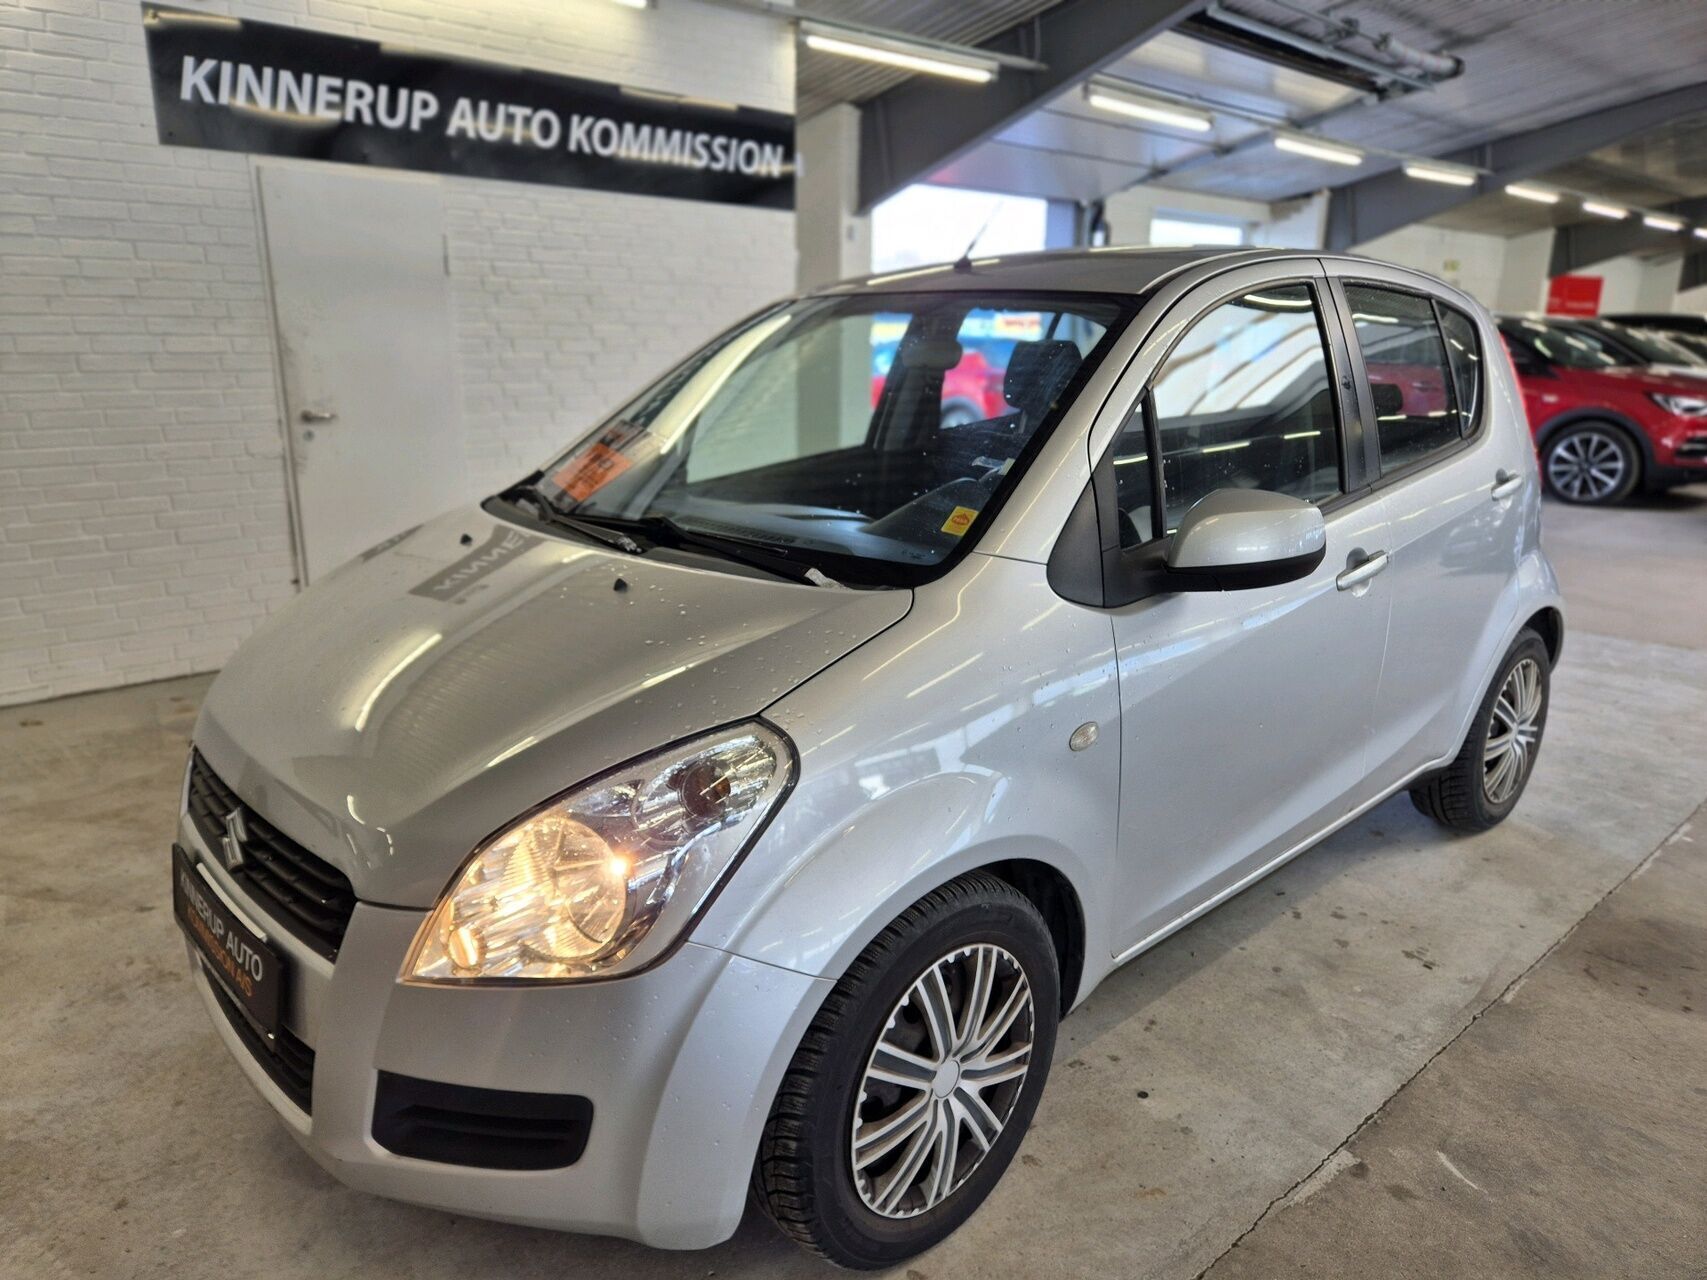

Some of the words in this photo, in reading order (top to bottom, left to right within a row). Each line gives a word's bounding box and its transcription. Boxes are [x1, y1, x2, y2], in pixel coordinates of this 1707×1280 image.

[180, 55, 440, 131] KINNERUP
[446, 97, 560, 149] AUTO
[568, 114, 784, 178] KOMMISSION
[226, 930, 263, 982] AUTO
